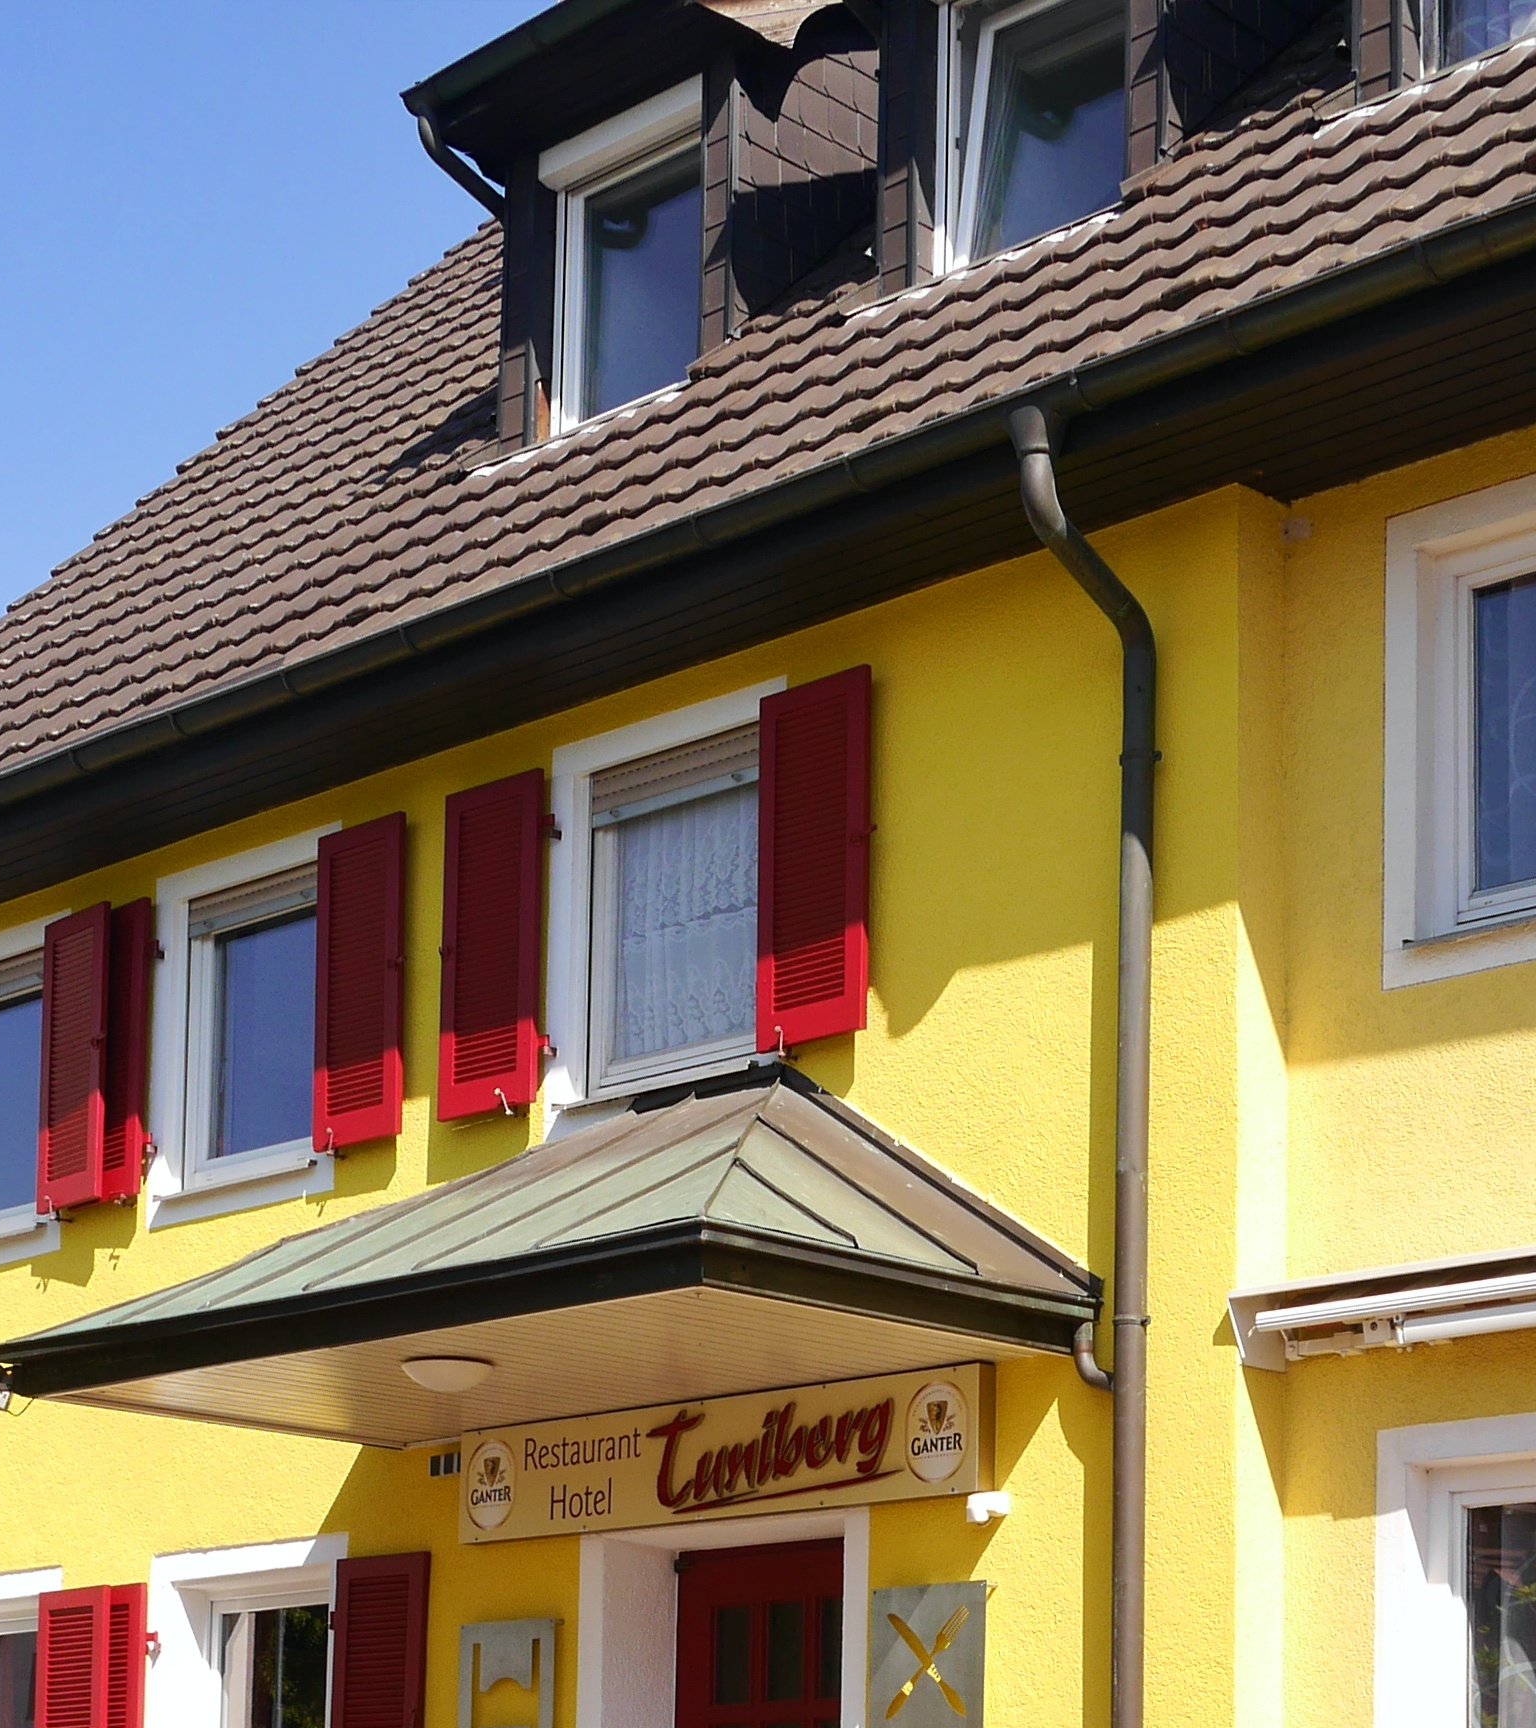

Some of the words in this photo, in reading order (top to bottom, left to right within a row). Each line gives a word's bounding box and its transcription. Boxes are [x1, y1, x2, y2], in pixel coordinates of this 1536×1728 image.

[524, 1427, 642, 1471] Restaurant
[646, 1397, 895, 1508] Tuniberg
[910, 1432, 963, 1456] GANTER
[470, 1485, 512, 1506] GANTER
[549, 1477, 613, 1520] Hotel
